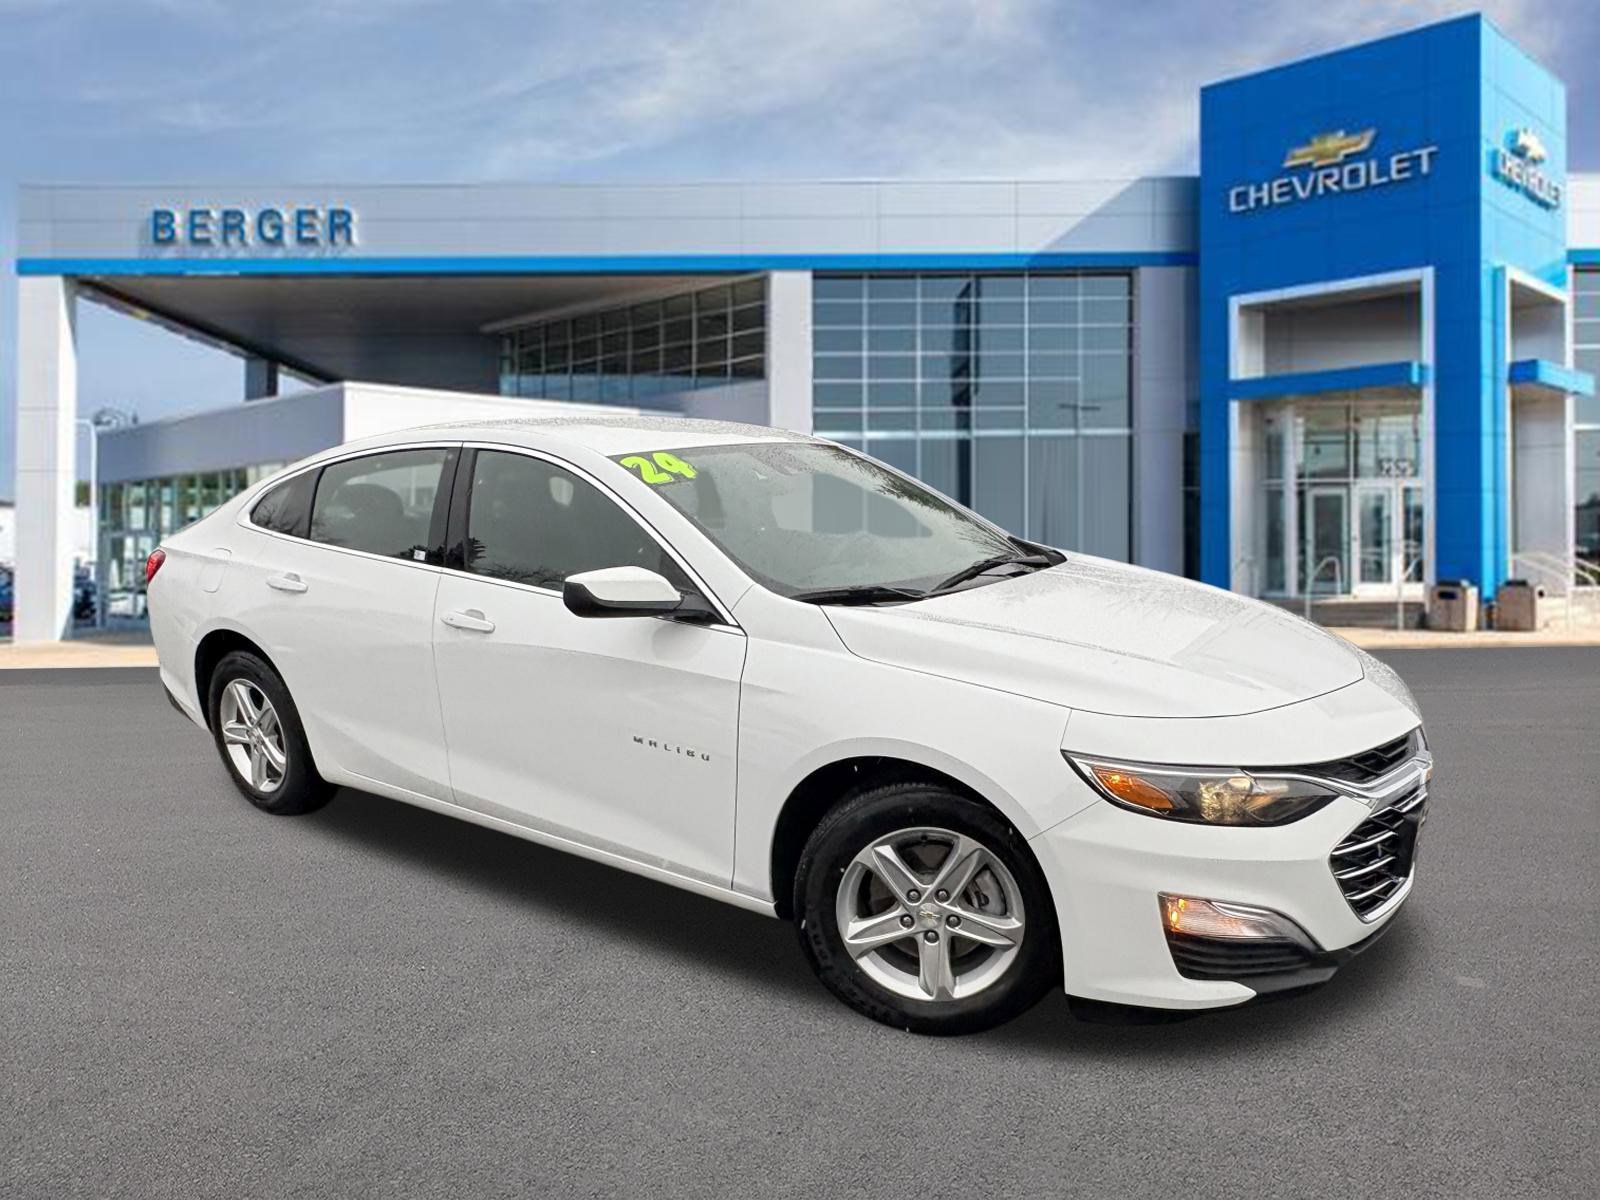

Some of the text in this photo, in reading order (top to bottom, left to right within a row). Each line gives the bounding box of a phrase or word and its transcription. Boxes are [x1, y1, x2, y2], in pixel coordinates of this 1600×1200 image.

[1229, 146, 1438, 213] CHEVROLET
[152, 208, 354, 246] BERGER
[619, 452, 698, 484] 24
[633, 735, 710, 762] MALIBU
